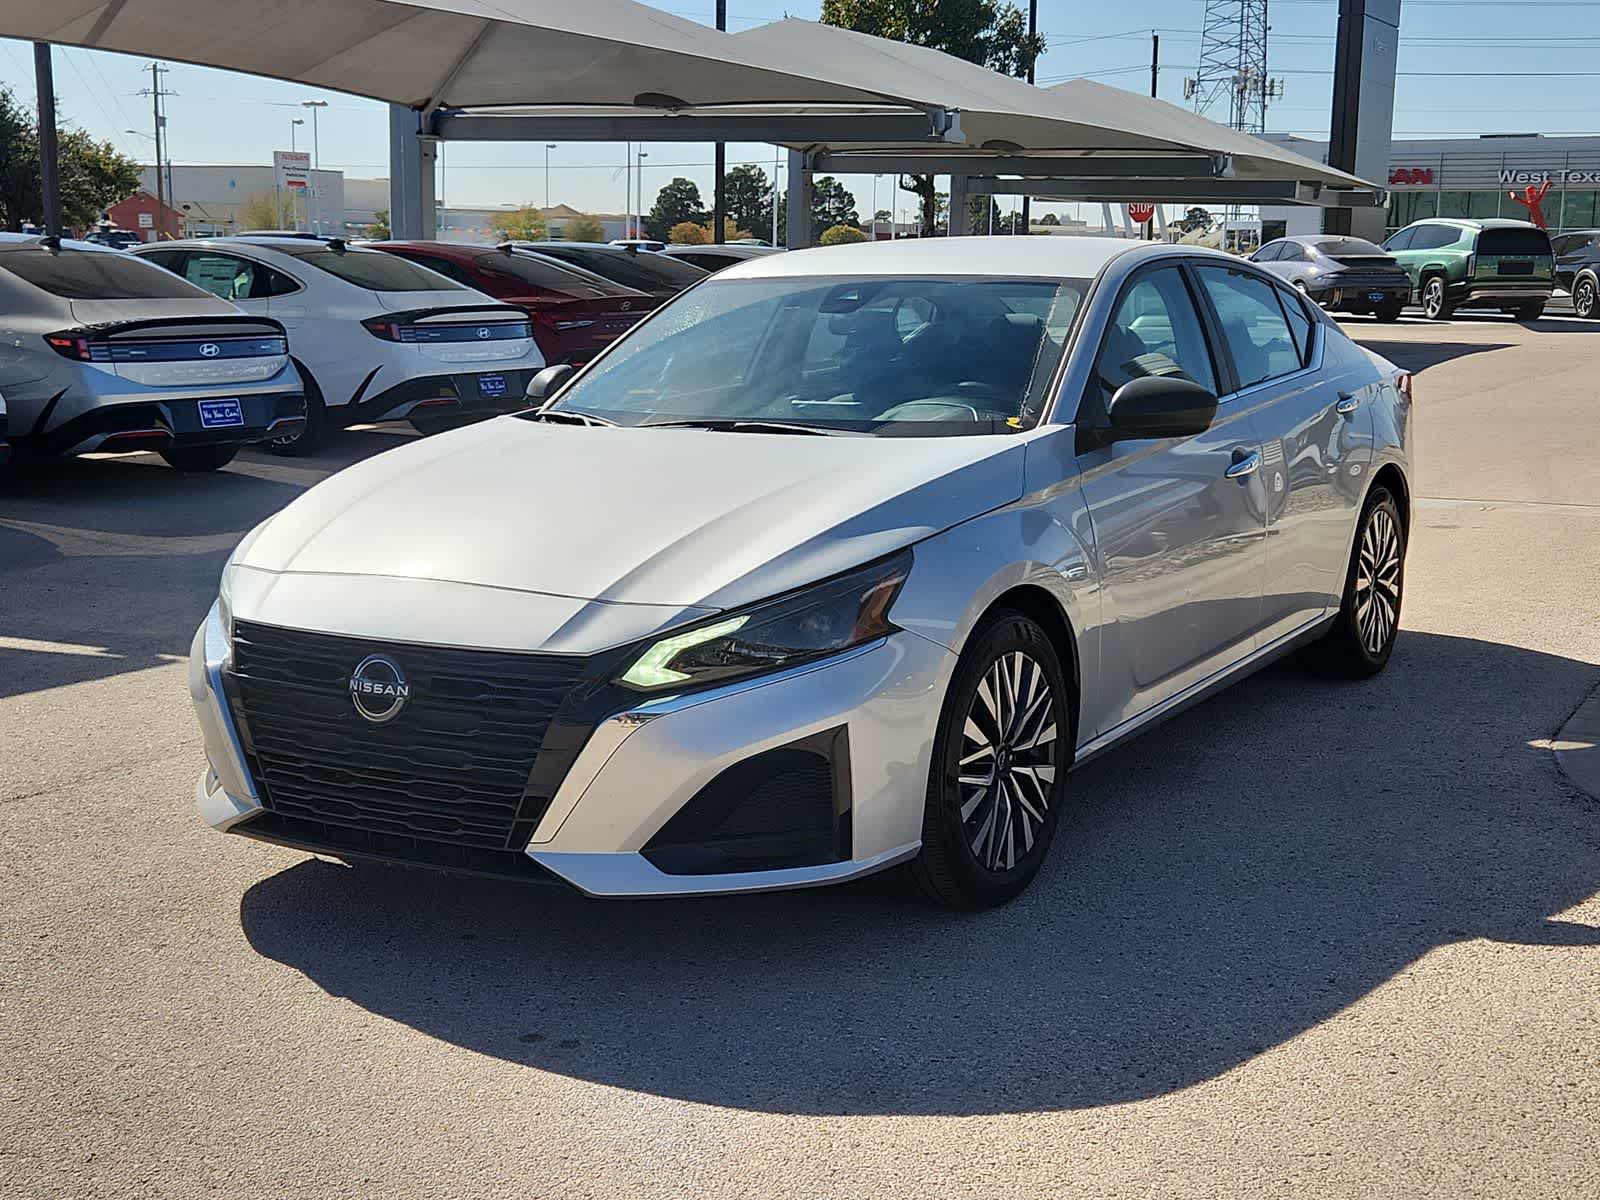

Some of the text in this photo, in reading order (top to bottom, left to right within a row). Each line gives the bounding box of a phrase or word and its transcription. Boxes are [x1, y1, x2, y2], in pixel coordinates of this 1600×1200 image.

[1498, 169, 1549, 184] West
[1130, 202, 1154, 213] STOP
[349, 679, 409, 696] NISSAN
